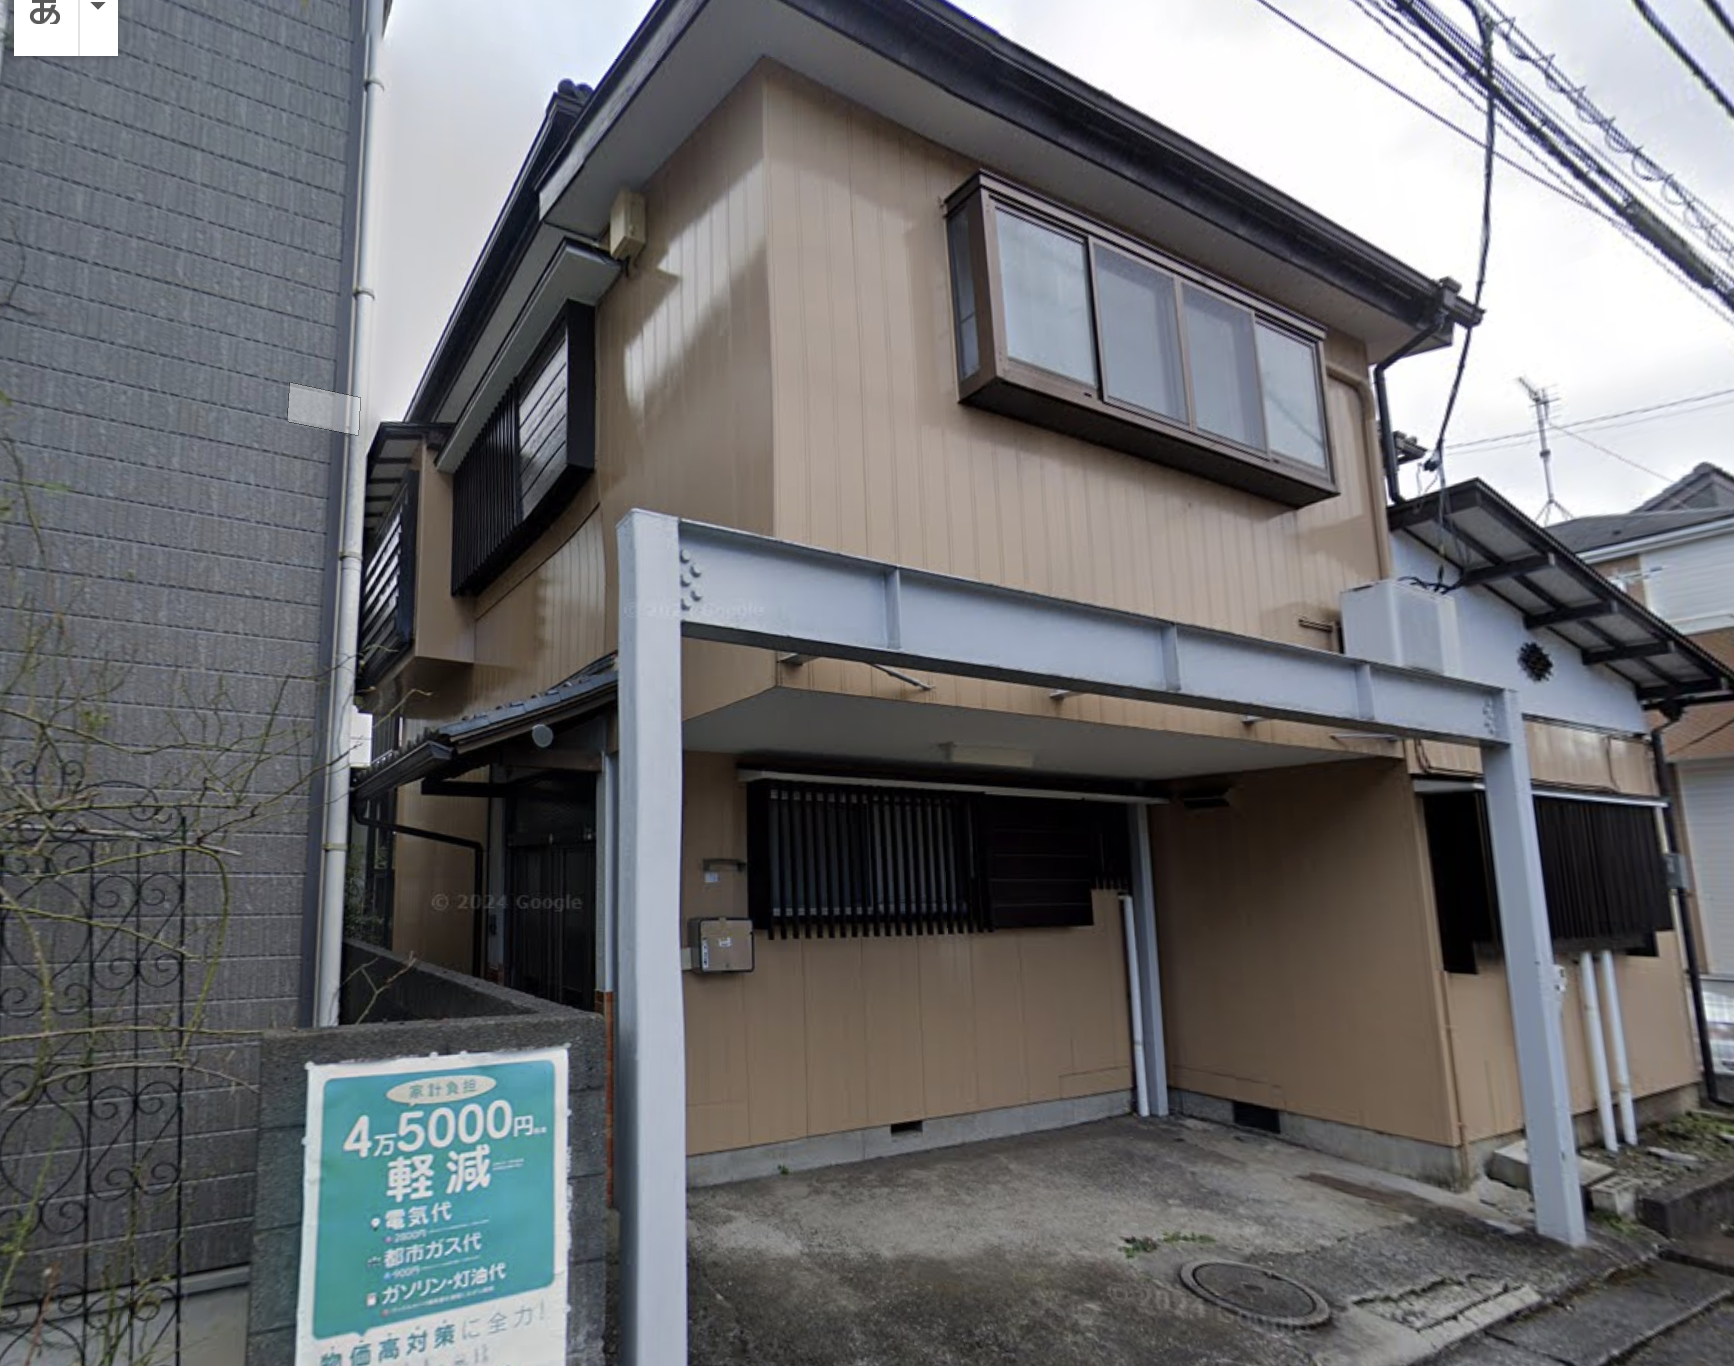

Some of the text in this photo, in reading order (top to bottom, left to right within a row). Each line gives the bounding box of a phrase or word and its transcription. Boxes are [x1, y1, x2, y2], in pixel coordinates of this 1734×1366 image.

[408, 1079, 478, 1099] 家計負担
[386, 1144, 491, 1202] 軽減
[385, 1201, 452, 1230] 電気代
[384, 1232, 482, 1268] 都市ガス代
[382, 1262, 506, 1305] ガソリン・灯油代
